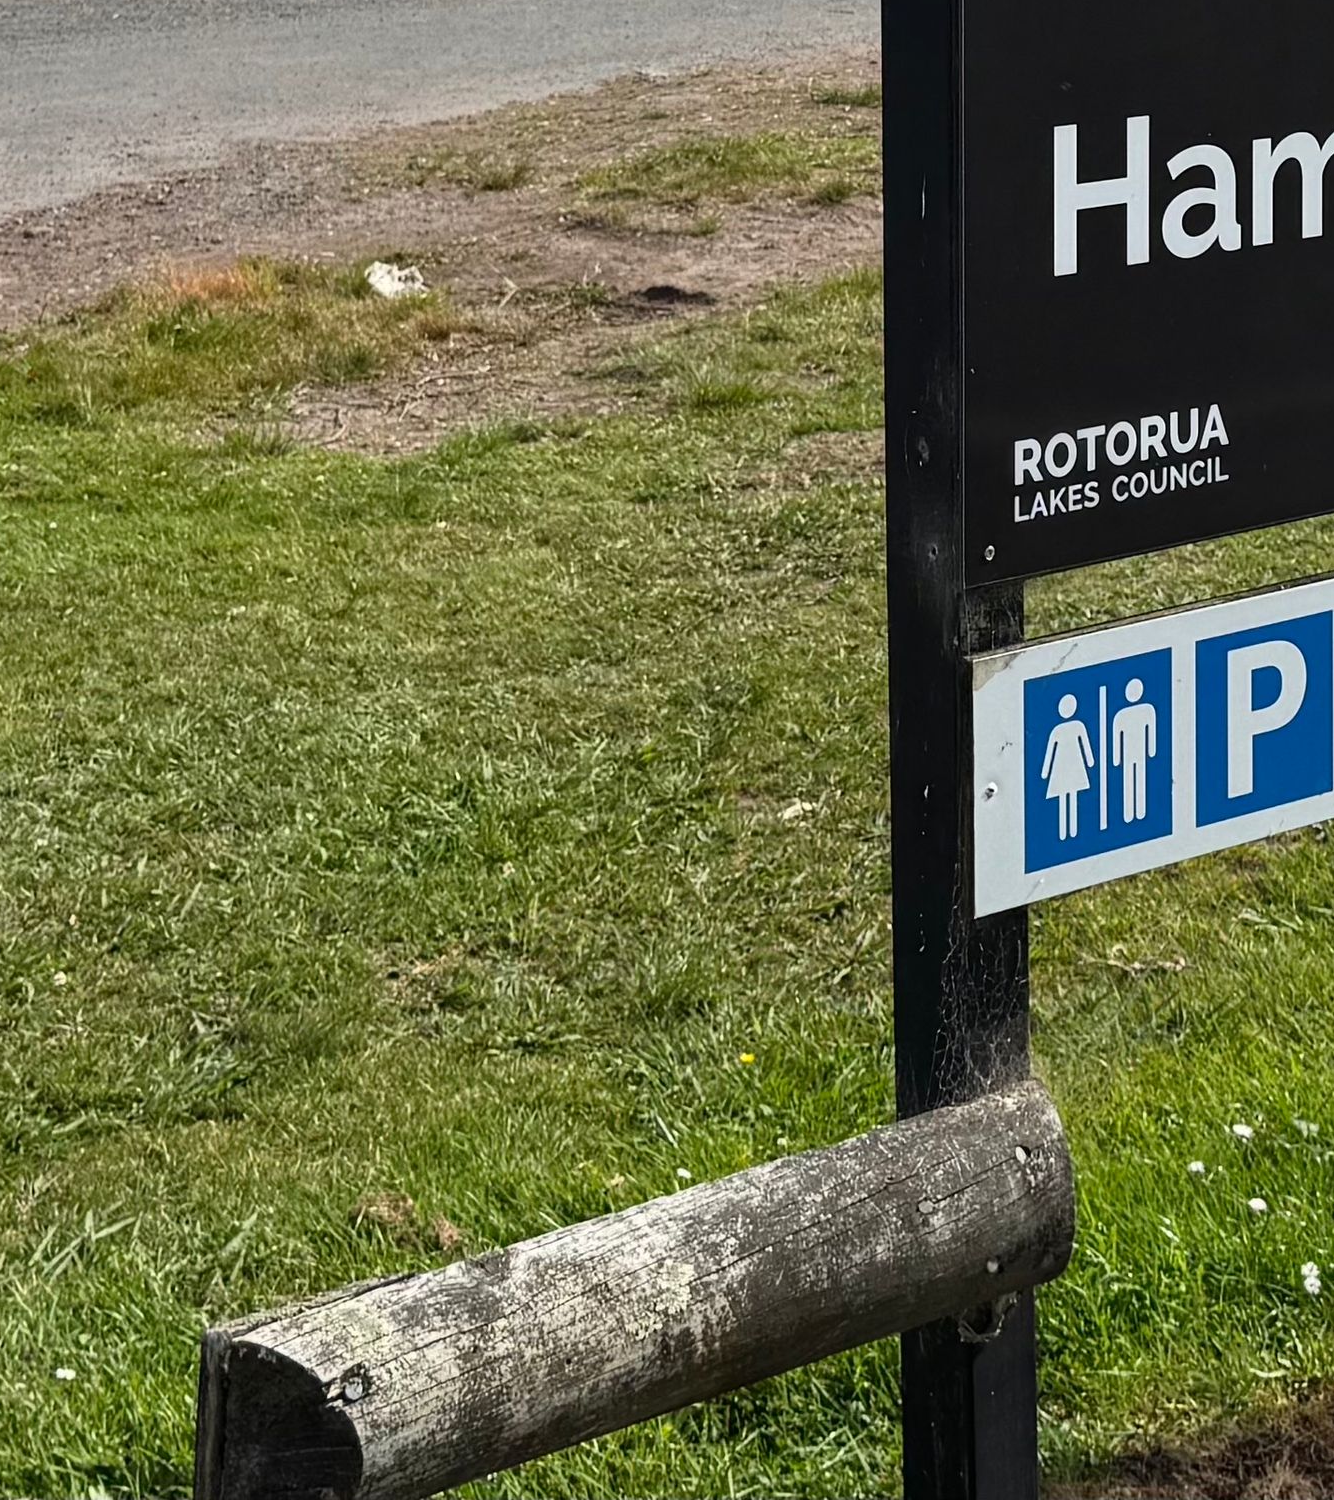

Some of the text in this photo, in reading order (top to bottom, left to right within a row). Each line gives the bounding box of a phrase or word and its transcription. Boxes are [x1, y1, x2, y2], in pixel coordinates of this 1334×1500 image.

[1014, 403, 1230, 486] ROTORUA
[1014, 456, 1230, 523] LAKES COUNCIL
